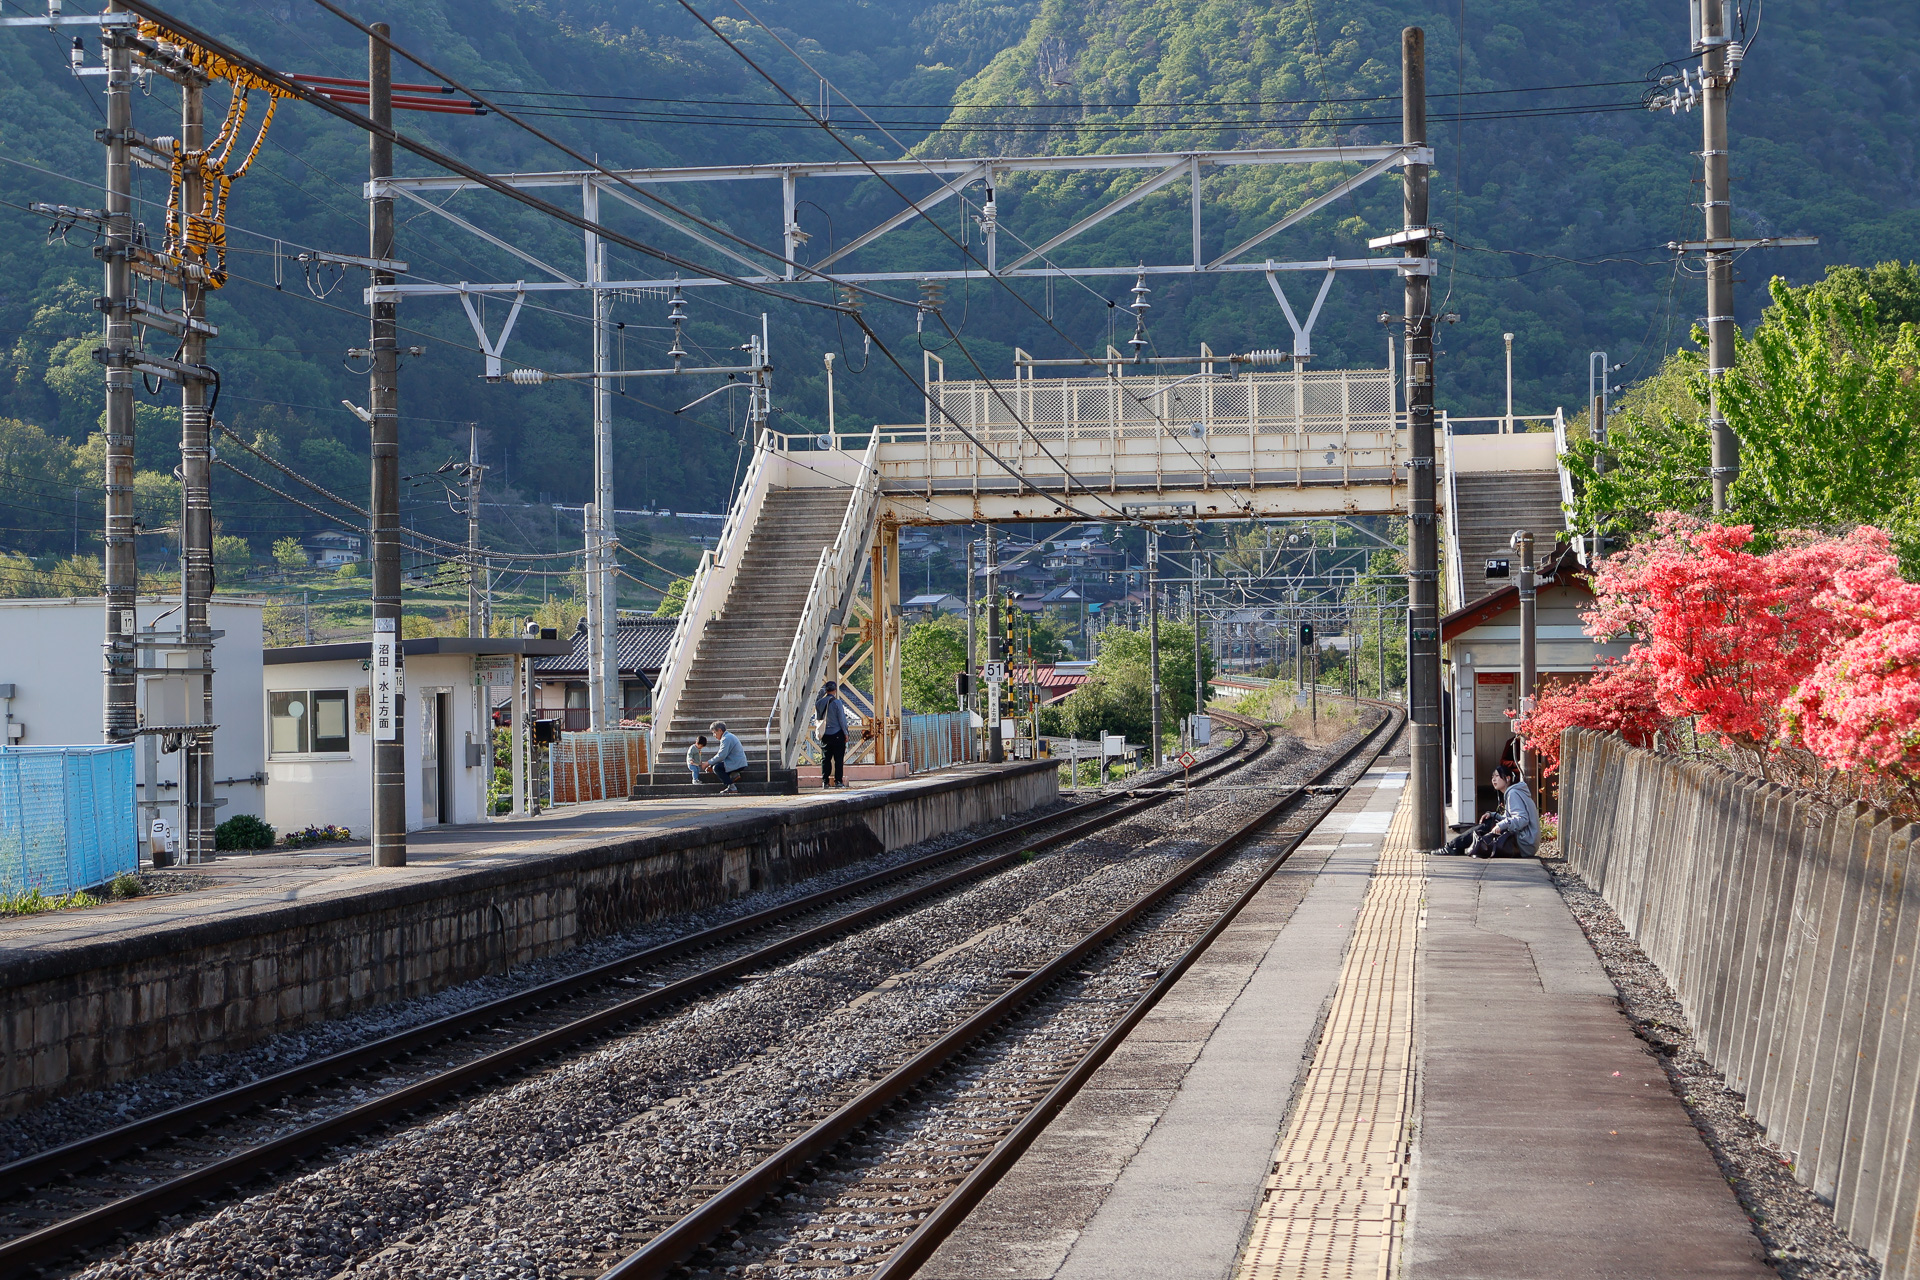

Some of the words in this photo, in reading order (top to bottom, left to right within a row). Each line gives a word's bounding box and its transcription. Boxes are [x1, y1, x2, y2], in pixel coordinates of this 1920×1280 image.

[124, 618, 132, 627] 17
[987, 663, 1001, 676] 51
[395, 676, 403, 686] 16
[378, 644, 389, 729] 沼田・水上方面
[153, 823, 164, 832] 3
[165, 827, 171, 838] 3
